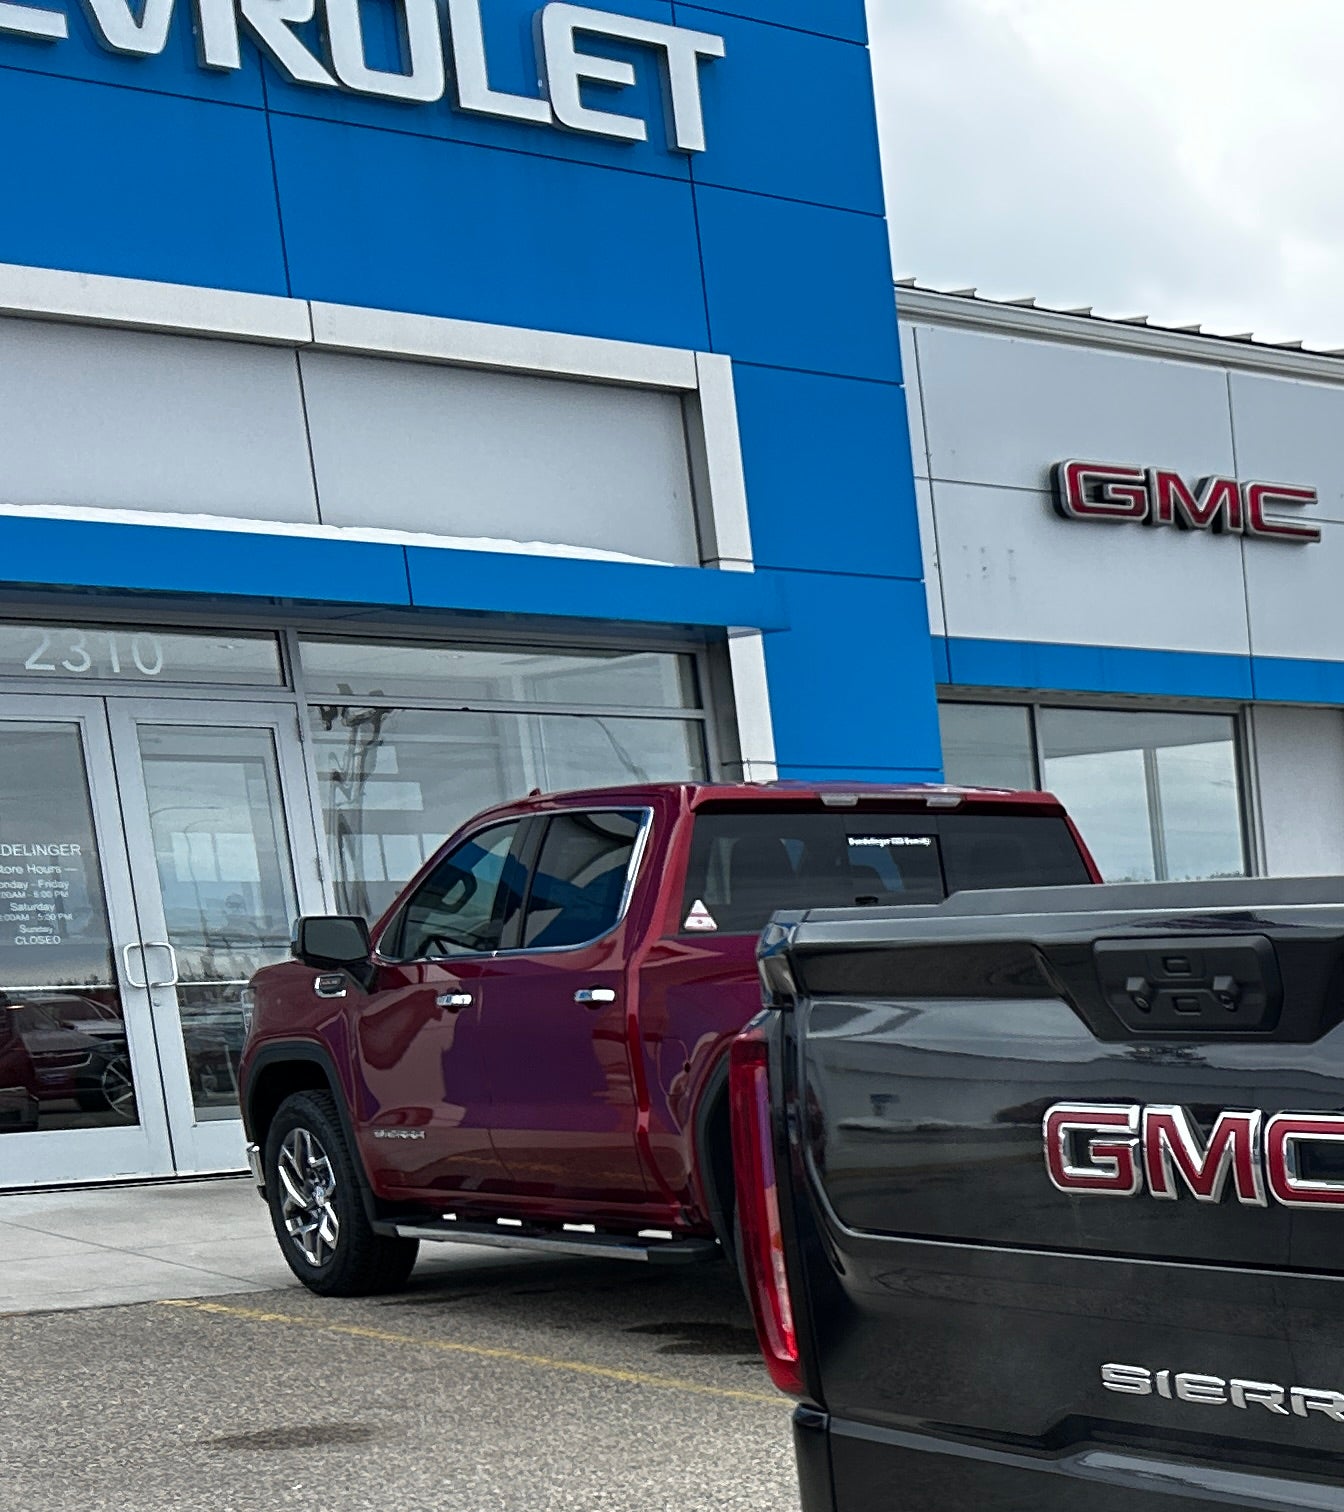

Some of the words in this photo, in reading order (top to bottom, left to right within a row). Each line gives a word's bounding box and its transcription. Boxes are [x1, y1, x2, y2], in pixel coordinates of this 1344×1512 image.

[1051, 458, 1321, 543] GMC
[25, 628, 163, 675] 2310
[15, 935, 62, 946] CLOSED
